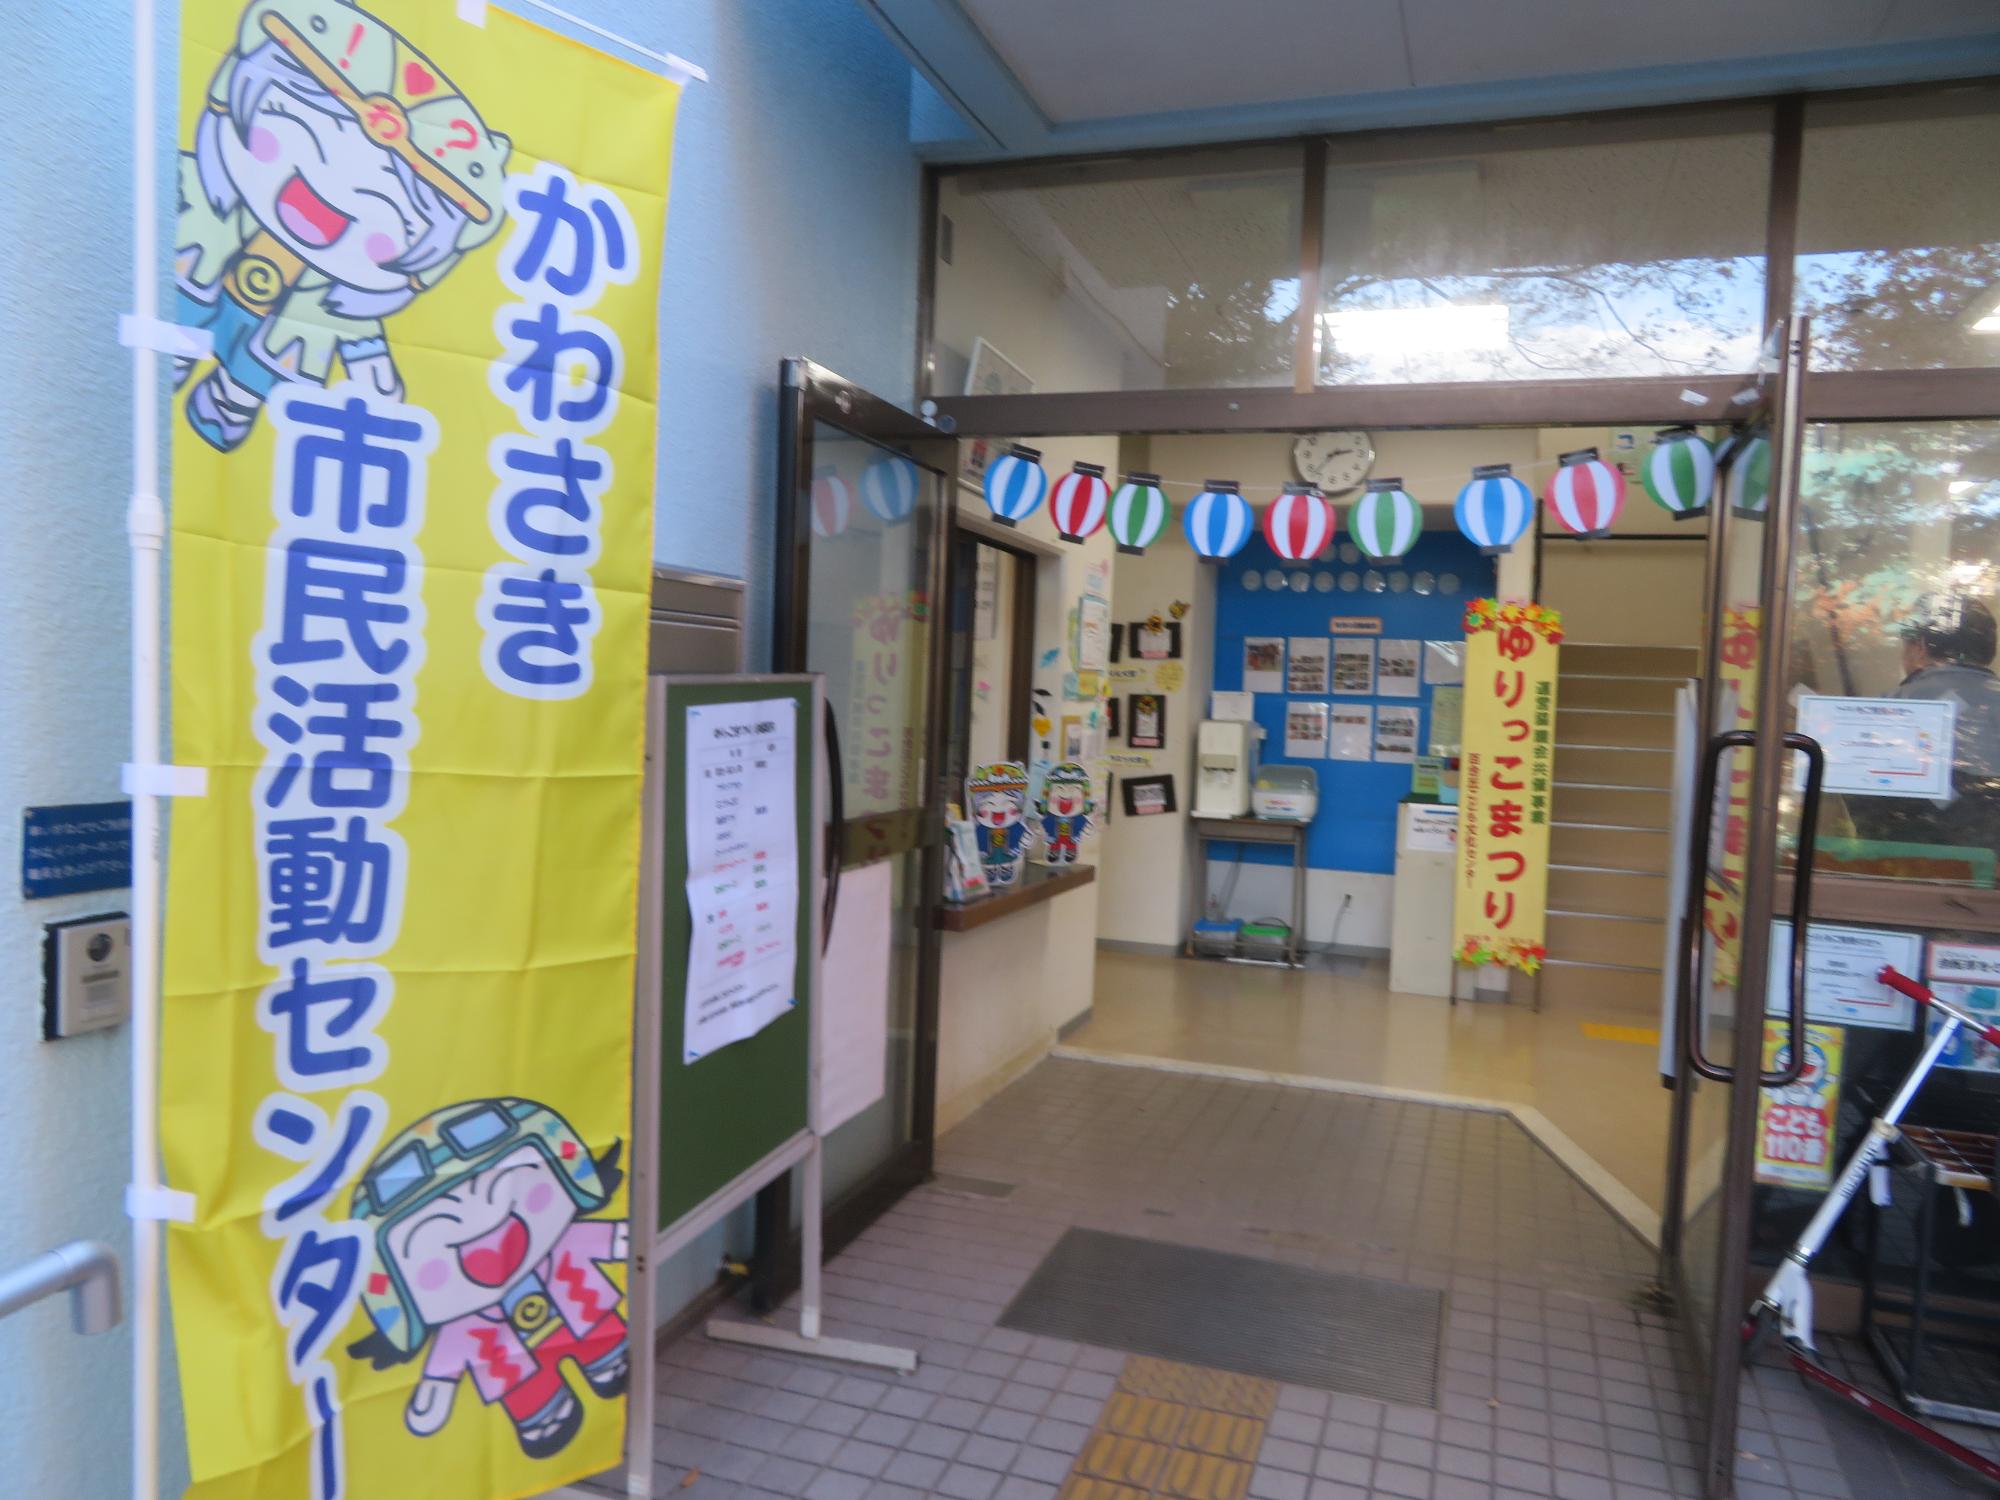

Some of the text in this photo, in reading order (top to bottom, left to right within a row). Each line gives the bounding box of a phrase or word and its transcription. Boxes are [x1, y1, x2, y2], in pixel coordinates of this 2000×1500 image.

[492, 175, 627, 686] かわさき
[265, 396, 424, 1500] 市民活動センター
[1484, 625, 1536, 930] ゆりっこまつり
[1765, 1108, 1826, 1140] こども
